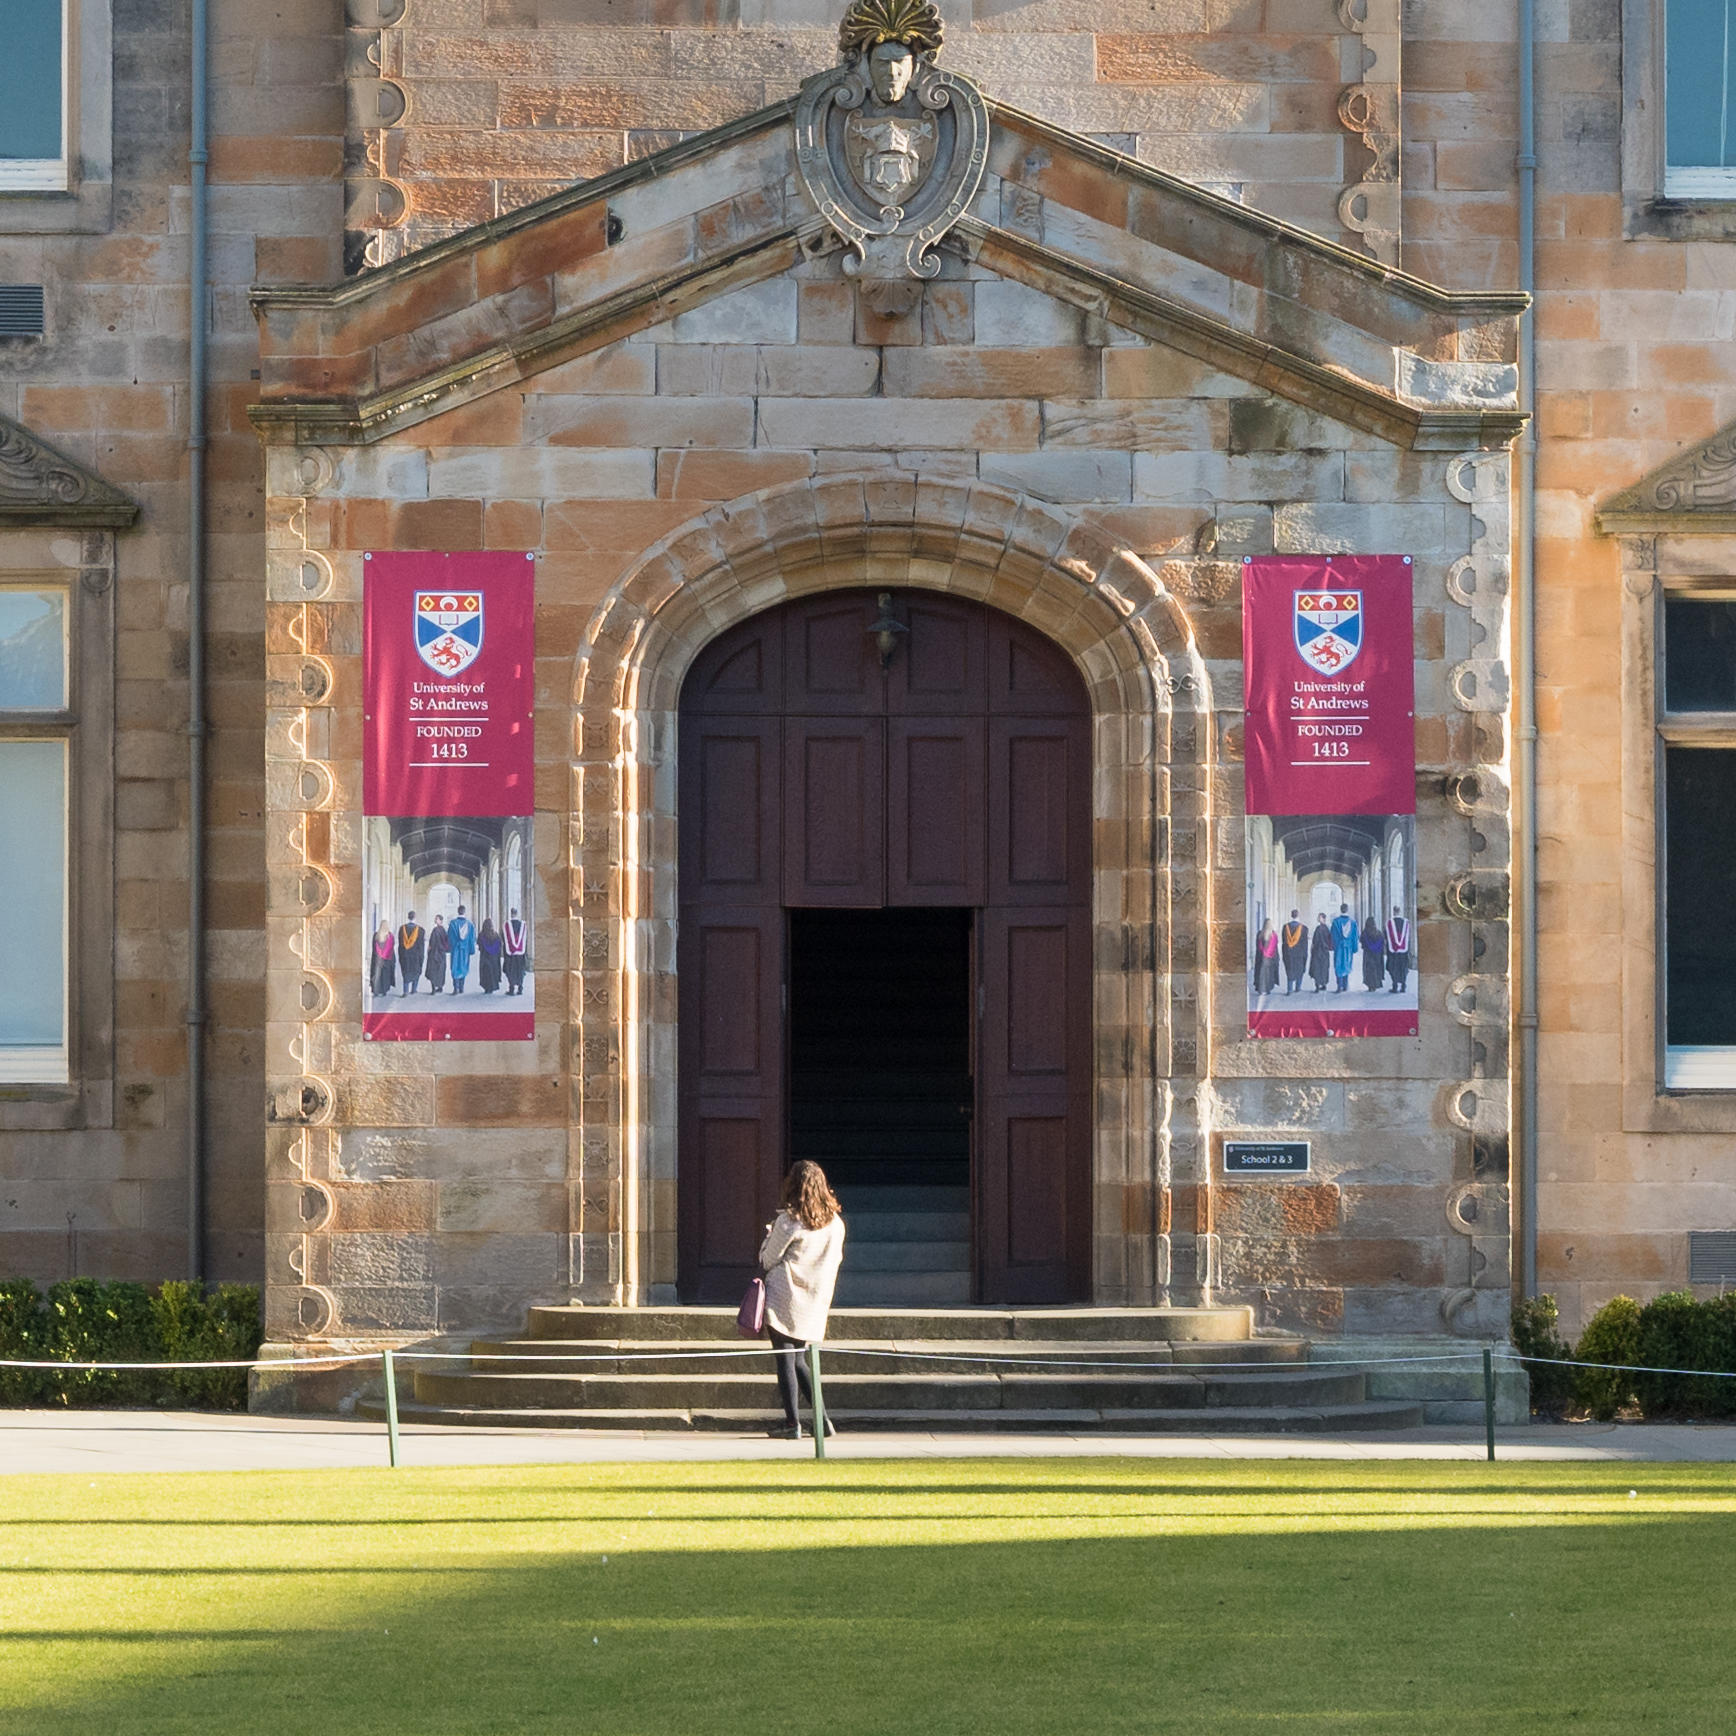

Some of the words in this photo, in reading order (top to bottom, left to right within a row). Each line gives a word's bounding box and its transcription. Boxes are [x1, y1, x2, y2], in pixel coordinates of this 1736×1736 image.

[413, 682, 471, 696] University
[472, 682, 485, 692] of
[1294, 681, 1351, 695] University
[1353, 681, 1365, 691] of
[409, 697, 424, 710] St
[426, 697, 488, 710] Andrews
[1290, 696, 1304, 709] St
[1307, 696, 1369, 710] Andrews
[416, 726, 482, 738] FOUNDED
[1297, 725, 1363, 737] FOUNDED
[431, 743, 468, 758] 1413
[1312, 742, 1349, 757] 1413
[1241, 1155, 1271, 1164] School
[1278, 1155, 1286, 1164] &
